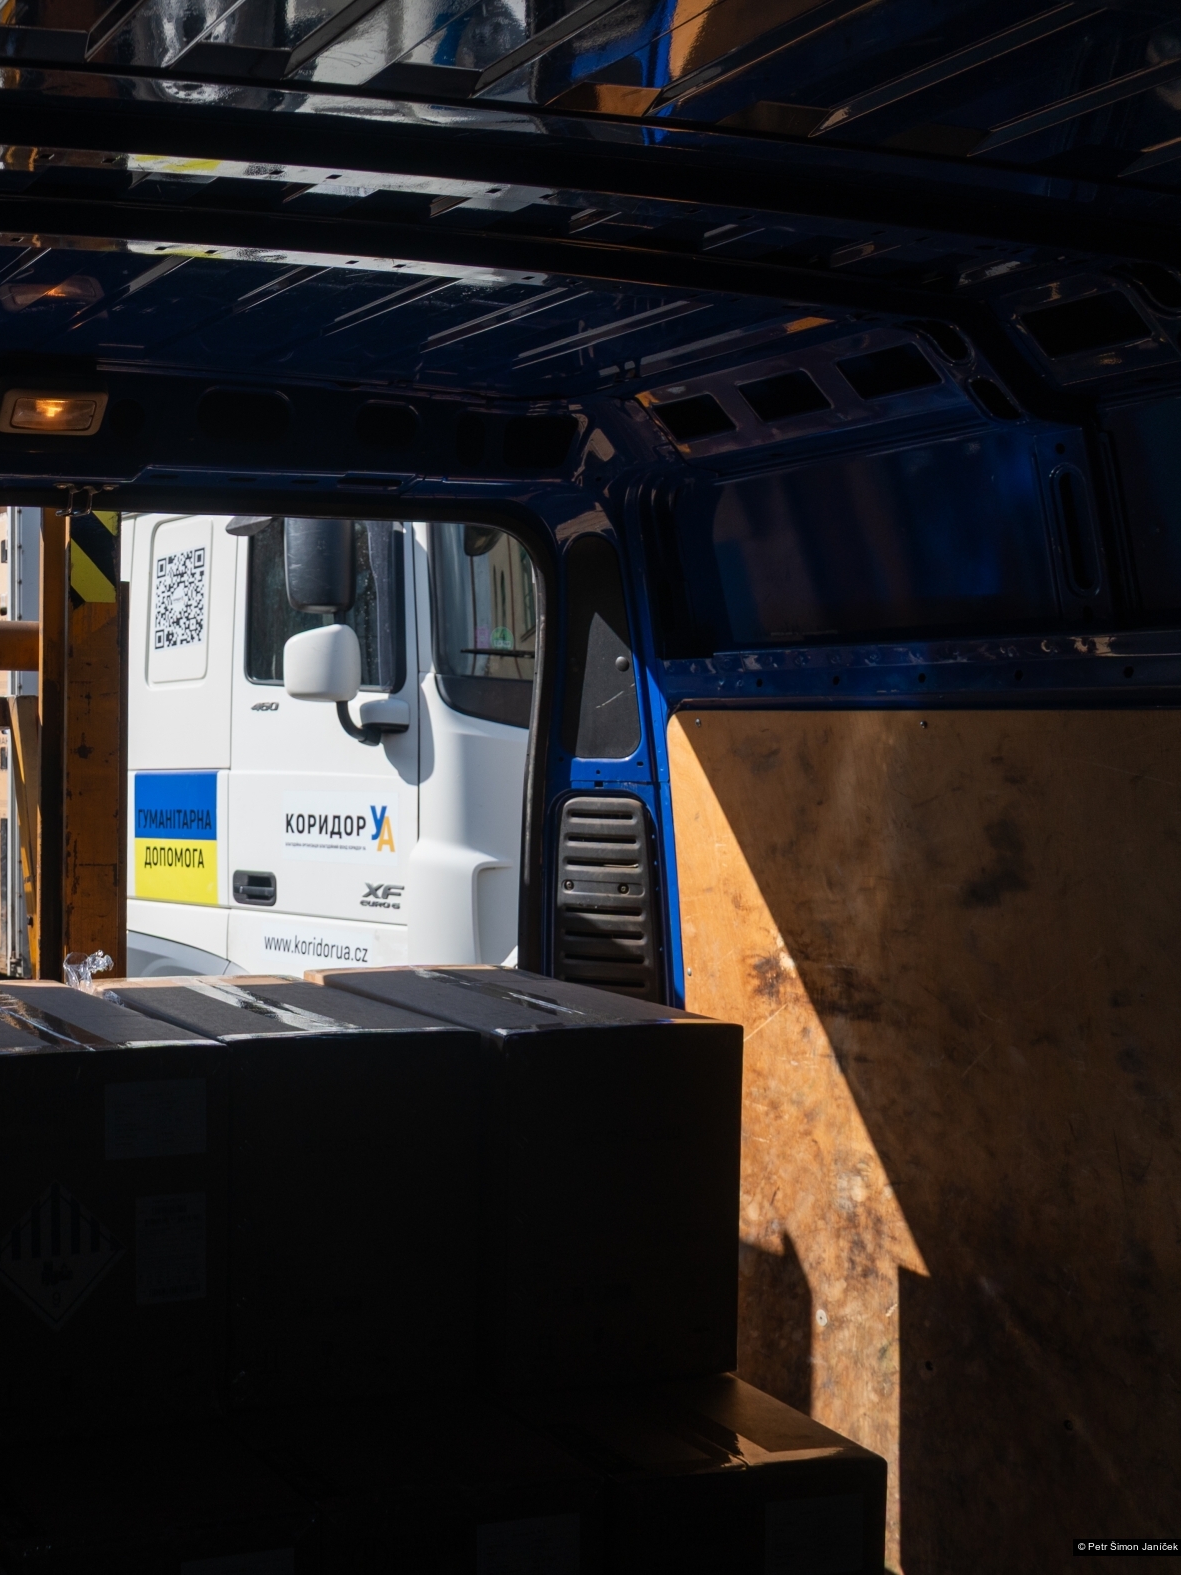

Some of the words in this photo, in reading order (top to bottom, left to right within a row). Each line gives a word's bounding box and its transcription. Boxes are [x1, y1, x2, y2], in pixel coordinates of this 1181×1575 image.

[251, 702, 279, 711] 460
[138, 809, 212, 830] ГУМАНІТАРНА
[285, 813, 366, 839] КОРИДОР
[144, 846, 205, 868] ДОПОМОГА
[362, 882, 405, 899] XF
[264, 935, 368, 963] www.koridorua.cz
